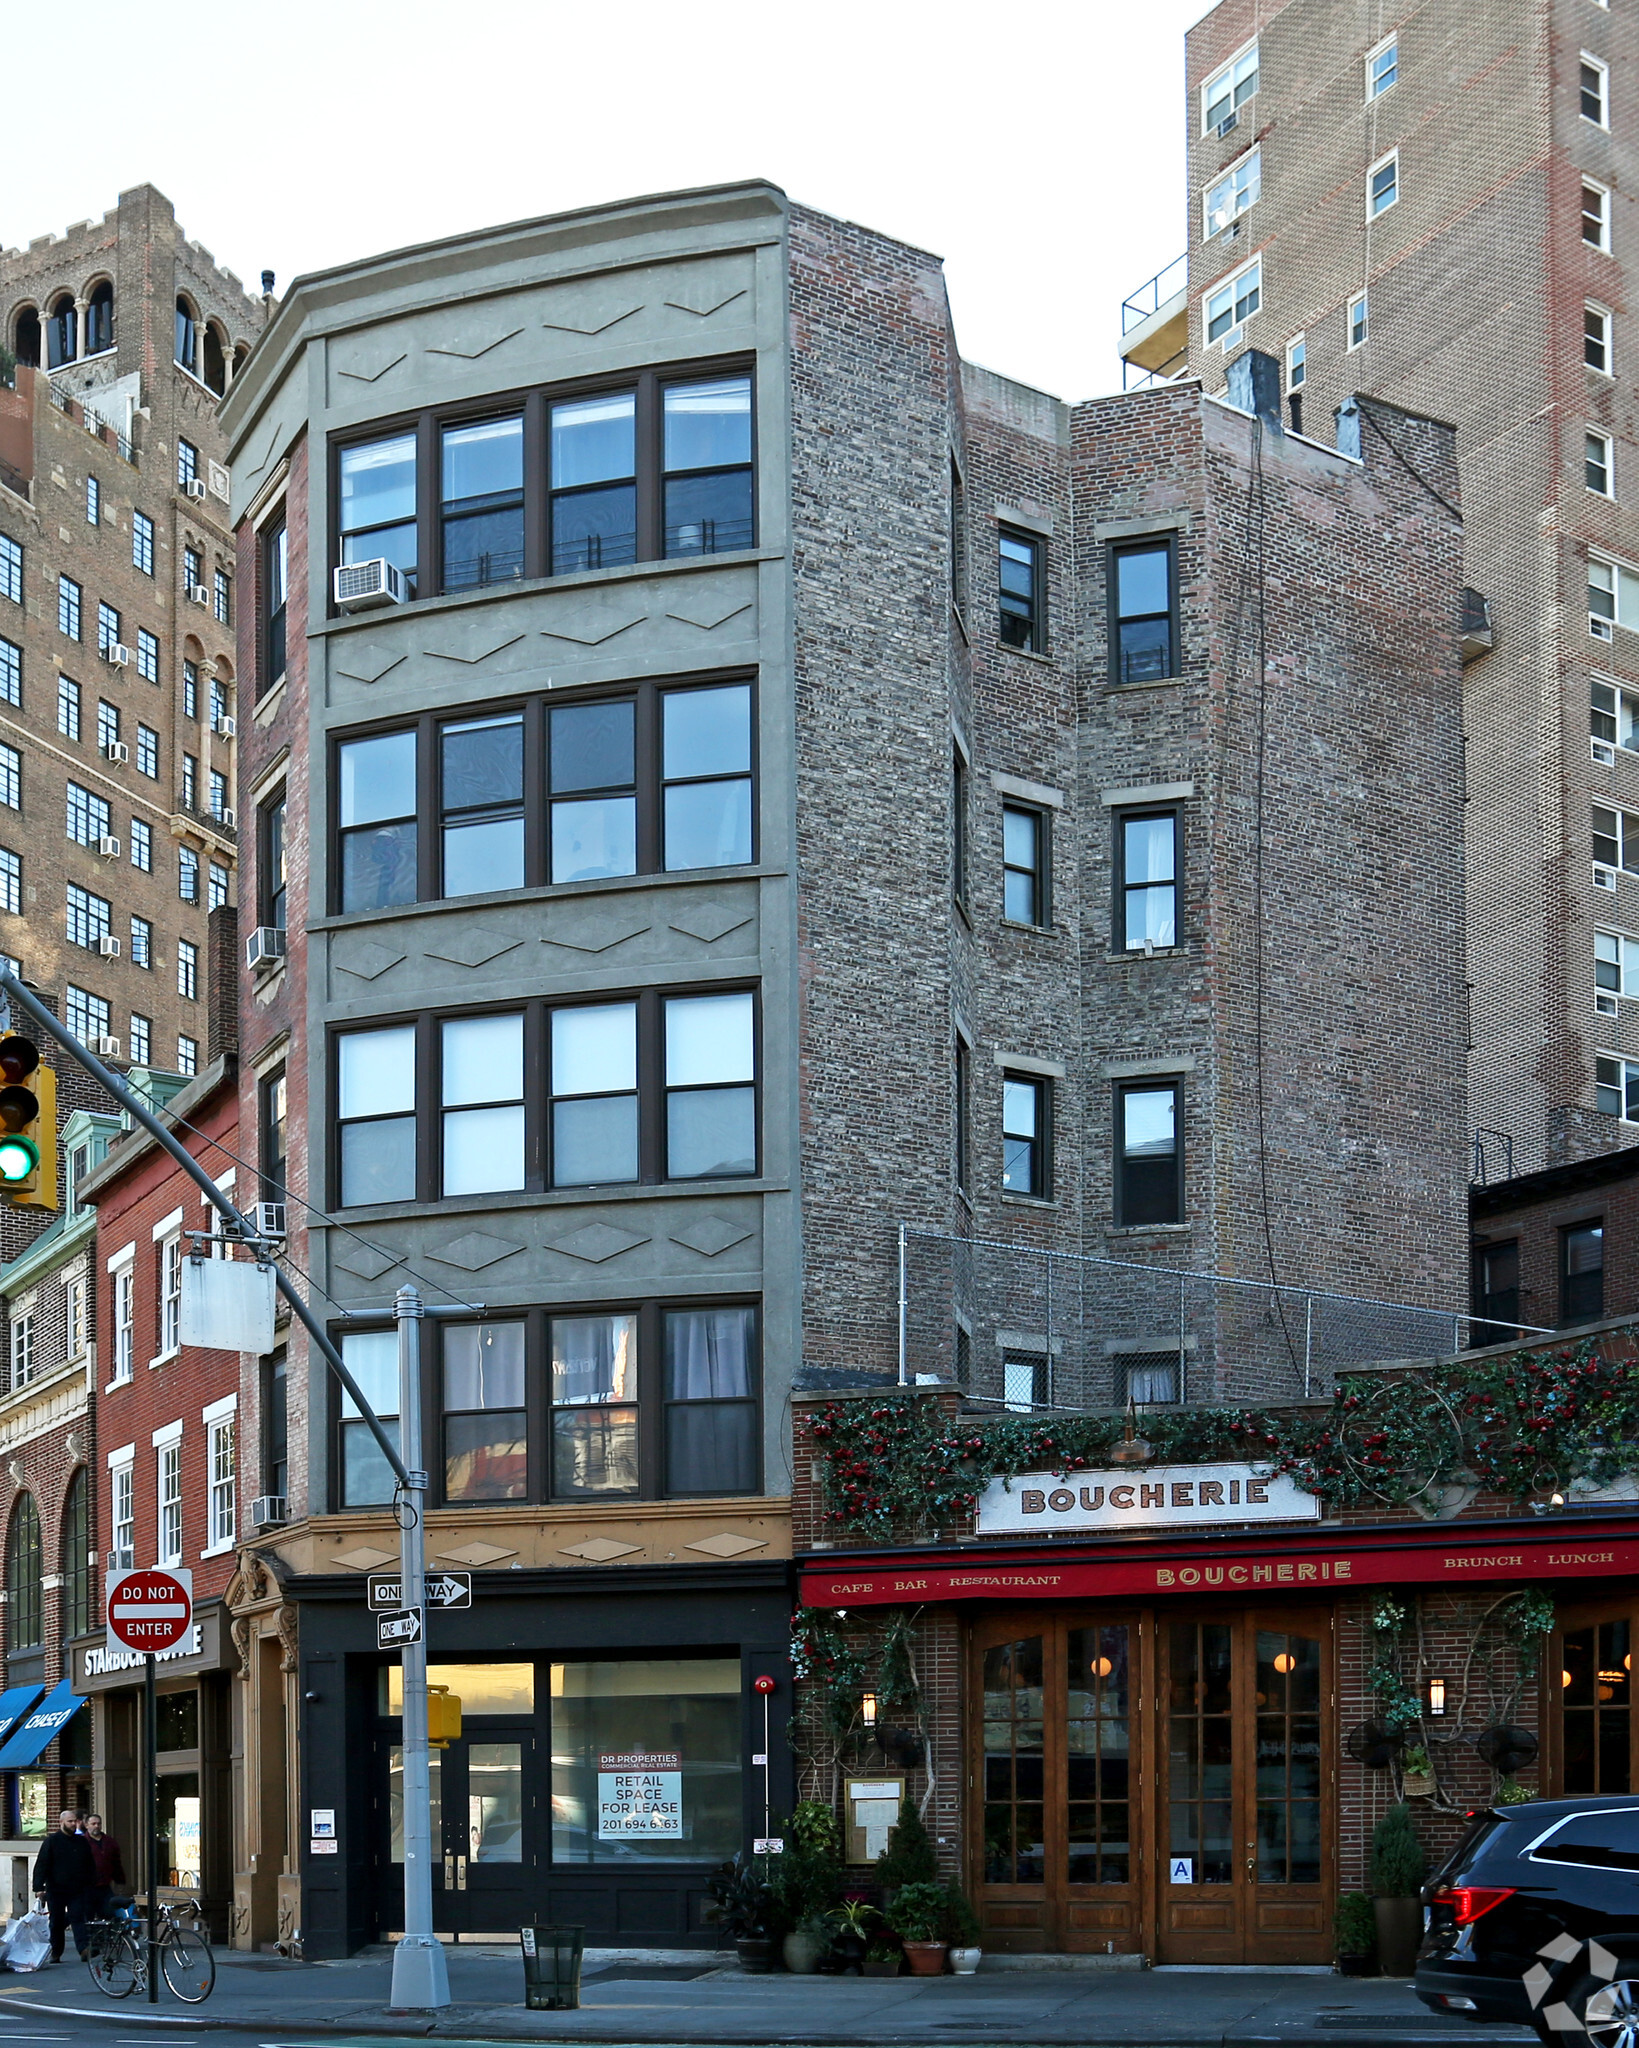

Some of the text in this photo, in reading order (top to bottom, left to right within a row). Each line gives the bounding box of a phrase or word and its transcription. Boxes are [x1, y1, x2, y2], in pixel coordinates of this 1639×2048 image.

[1021, 1478, 1269, 1514] BOUCHERIE
[1444, 1552, 1614, 1568] BRUNCH LUNCH
[1156, 1561, 1352, 1586] BOUCHERIE
[424, 1584, 456, 1598] WAY
[831, 1575, 1061, 1594] CAFE BAR RESTAURANT
[122, 1586, 176, 1600] DO NOT
[126, 1623, 172, 1636] ENTER
[382, 1619, 415, 1637] ONE WAY
[601, 1754, 678, 1764] DR PROPERTIES
[615, 1776, 664, 1787] RETAIL
[616, 1789, 662, 1800] SPACE
[602, 1802, 678, 1814] FOR LEASE
[602, 1819, 679, 1830] 201 694 663
[1174, 1861, 1188, 1876] A
